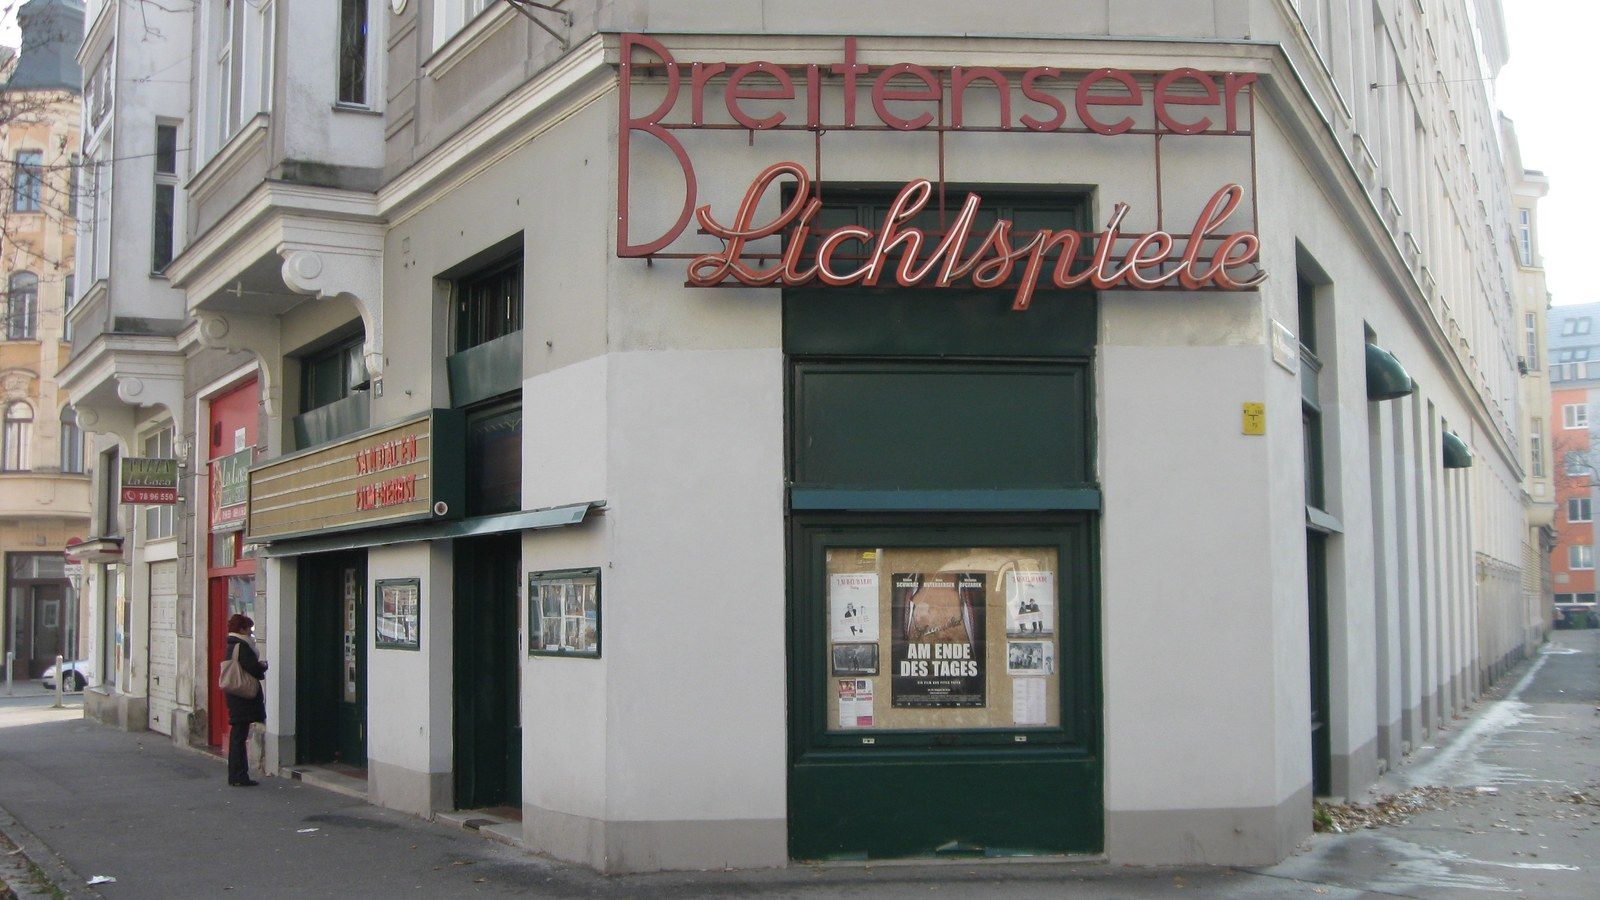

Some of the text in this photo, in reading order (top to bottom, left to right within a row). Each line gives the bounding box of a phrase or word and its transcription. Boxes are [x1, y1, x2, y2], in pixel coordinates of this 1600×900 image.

[617, 33, 1257, 257] Breitenseer
[686, 161, 1269, 311] Lichtspiele
[129, 459, 169, 472] PIZZA
[149, 493, 159, 501] 96
[160, 493, 174, 501] 550
[907, 643, 971, 659] AM ENDE
[900, 660, 978, 677] DES TAGES
